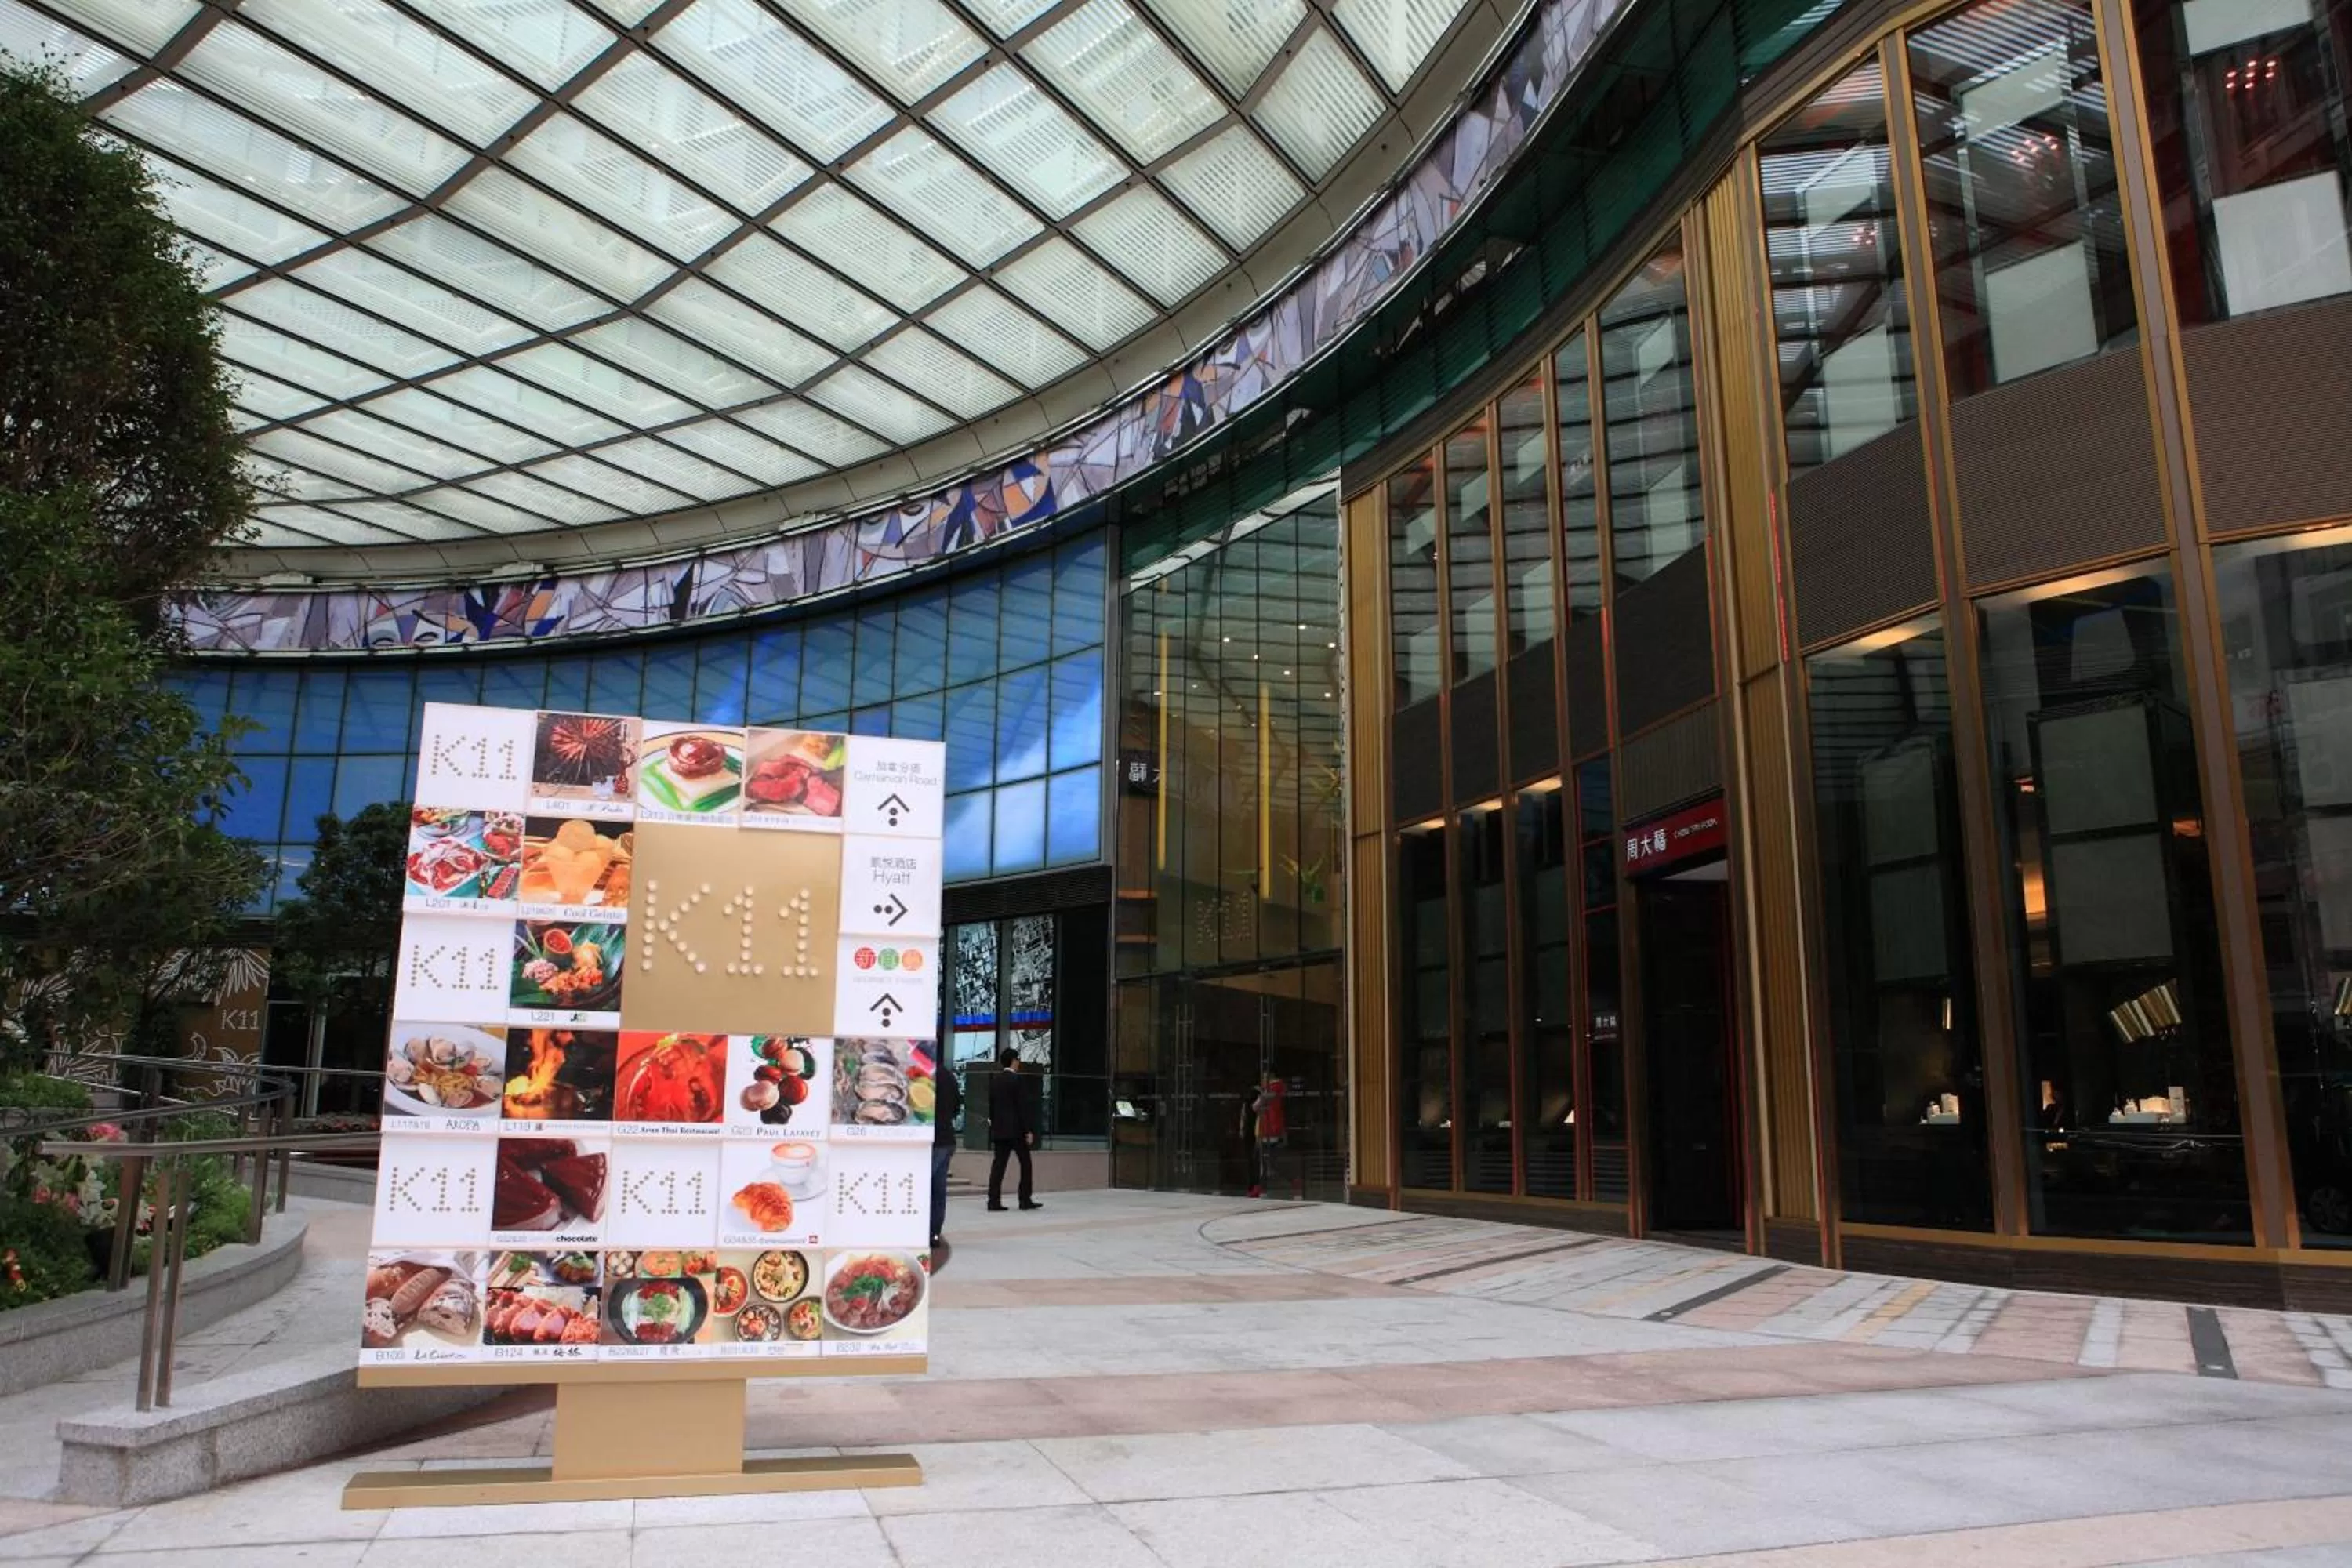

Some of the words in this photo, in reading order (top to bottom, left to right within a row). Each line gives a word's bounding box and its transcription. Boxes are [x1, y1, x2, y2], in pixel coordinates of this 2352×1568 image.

[430, 735, 516, 781] K11
[909, 774, 938, 786] Road
[1626, 829, 1667, 862] 周大福
[873, 869, 910, 887] Hyatt
[641, 879, 818, 979] K11
[410, 943, 499, 992] K11
[220, 1009, 260, 1030] K11
[389, 1165, 481, 1214] K11
[621, 1169, 706, 1216] K11
[837, 1171, 920, 1216] K11
